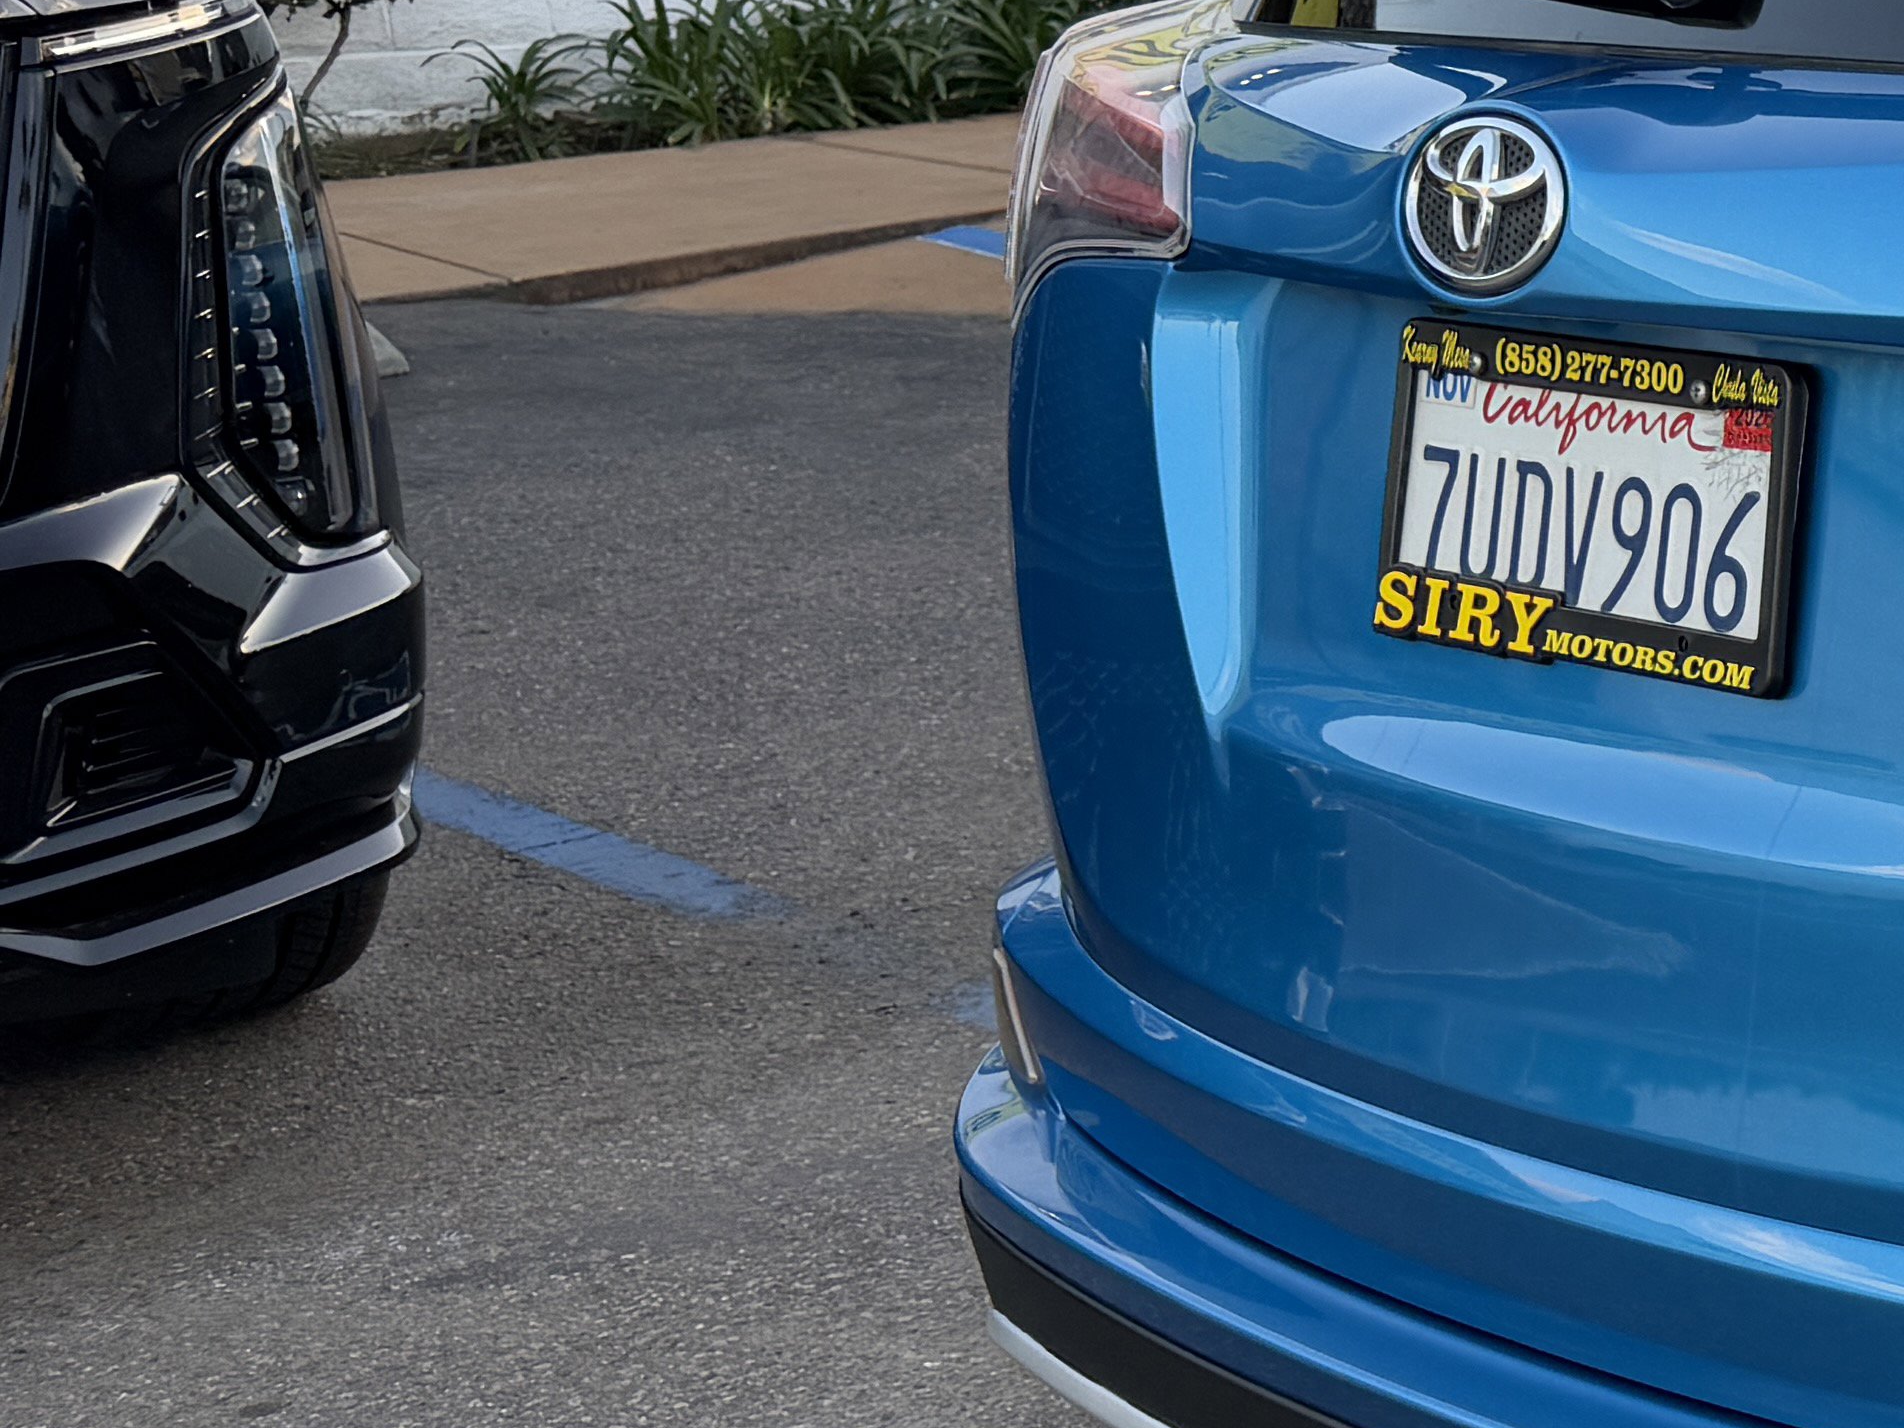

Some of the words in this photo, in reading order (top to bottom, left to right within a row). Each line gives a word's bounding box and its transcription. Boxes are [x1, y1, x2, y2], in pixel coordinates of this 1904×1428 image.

[1425, 373, 1472, 404] NOV
[1495, 337, 1562, 383] (858)
[1566, 349, 1685, 395] 277-7300
[1481, 382, 1718, 456] California
[1423, 443, 1763, 634] 7UDV906
[1373, 570, 1555, 656] SIRY
[1541, 628, 1755, 691] MOTORS.COM
